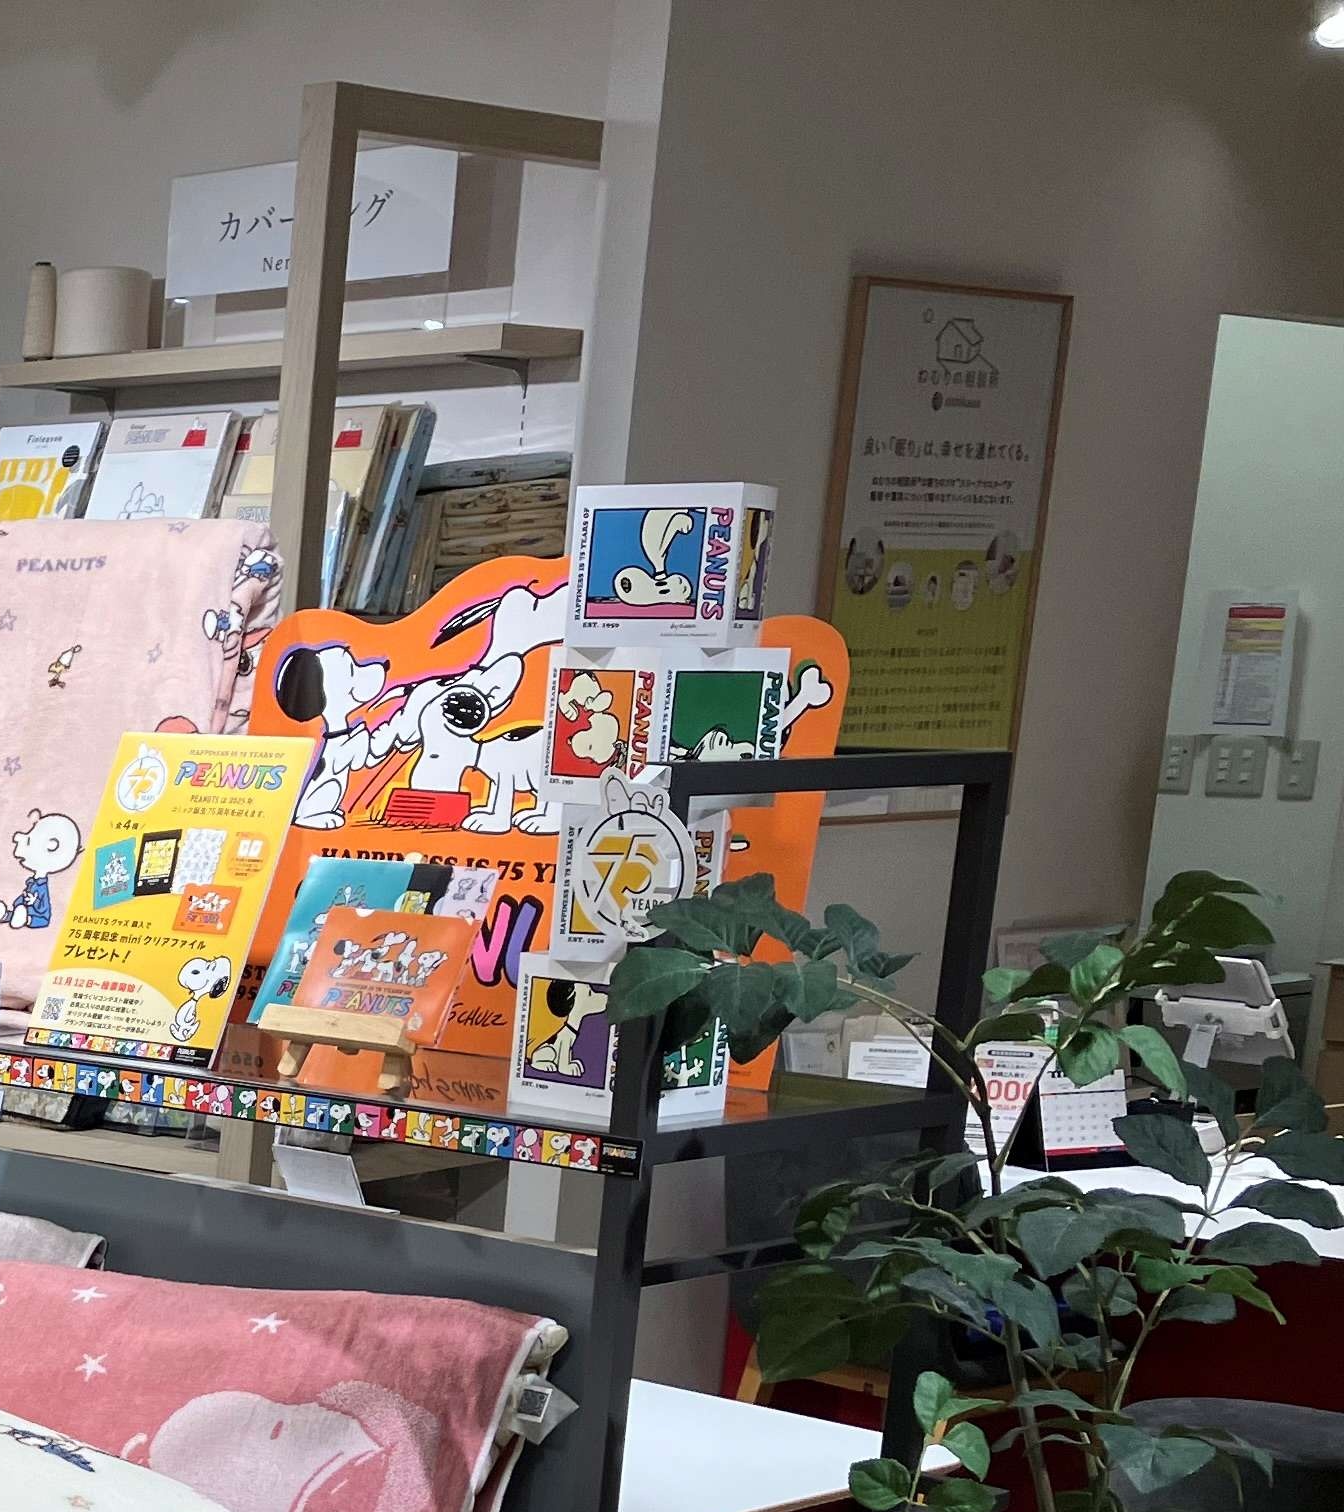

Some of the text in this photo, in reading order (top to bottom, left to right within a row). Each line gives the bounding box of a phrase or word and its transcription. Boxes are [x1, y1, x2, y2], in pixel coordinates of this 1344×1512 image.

[16, 555, 108, 573] PEANUTS
[701, 507, 734, 621] PEANUTS
[174, 761, 287, 791] PEANUTS
[320, 987, 414, 1017] PEANUTS
